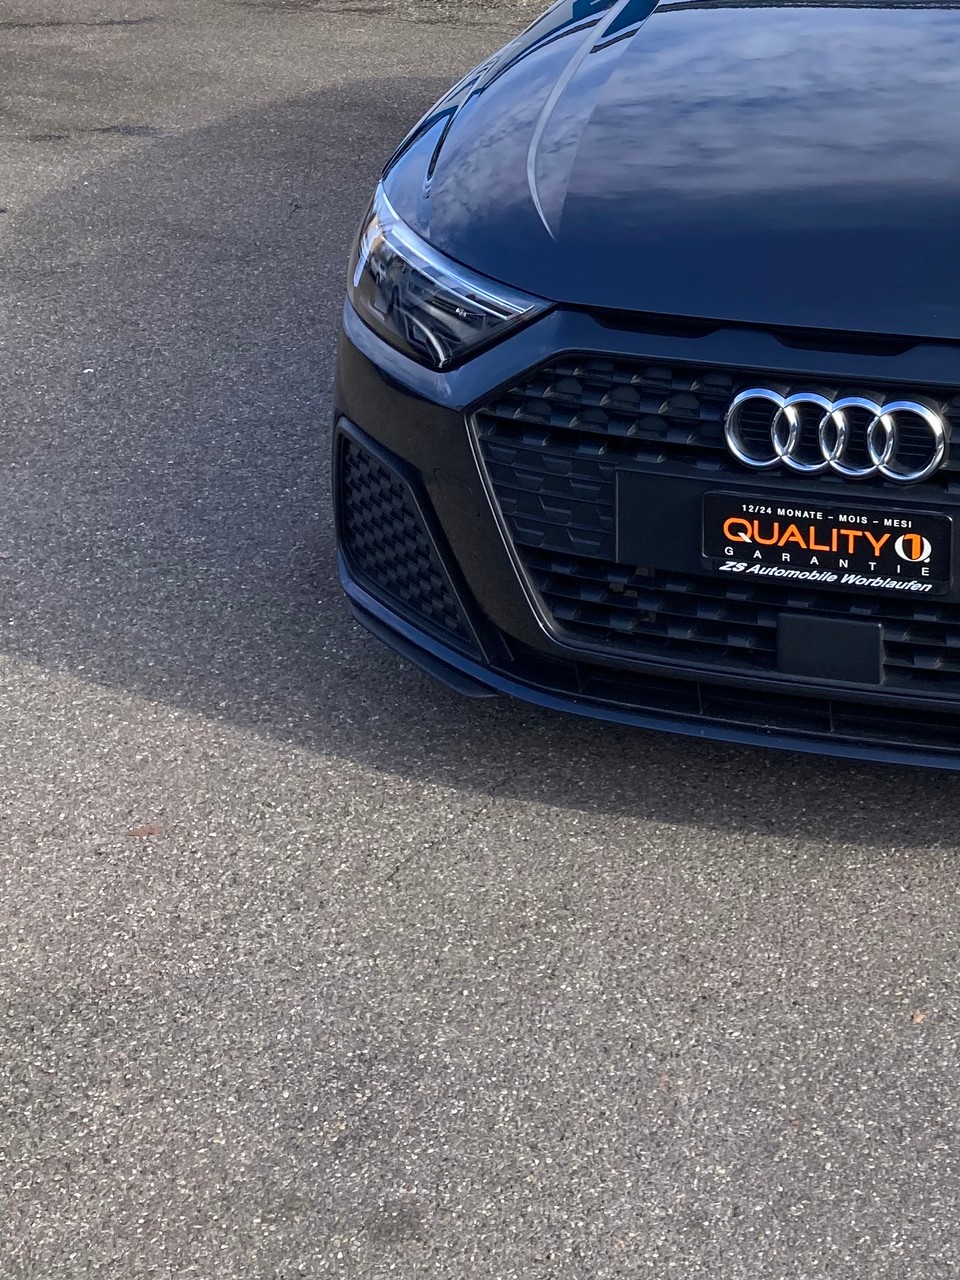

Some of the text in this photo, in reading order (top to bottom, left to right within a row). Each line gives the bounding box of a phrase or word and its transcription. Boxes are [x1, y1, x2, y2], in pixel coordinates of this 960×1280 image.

[741, 504, 772, 515] 12/24
[777, 508, 823, 520] MONATE
[839, 514, 868, 524] MOIS
[883, 518, 912, 529] MESI
[723, 517, 891, 557] QUALITY
[719, 560, 933, 593] ZS Automobile Worblaufen
[724, 546, 930, 577] GARANTIE
